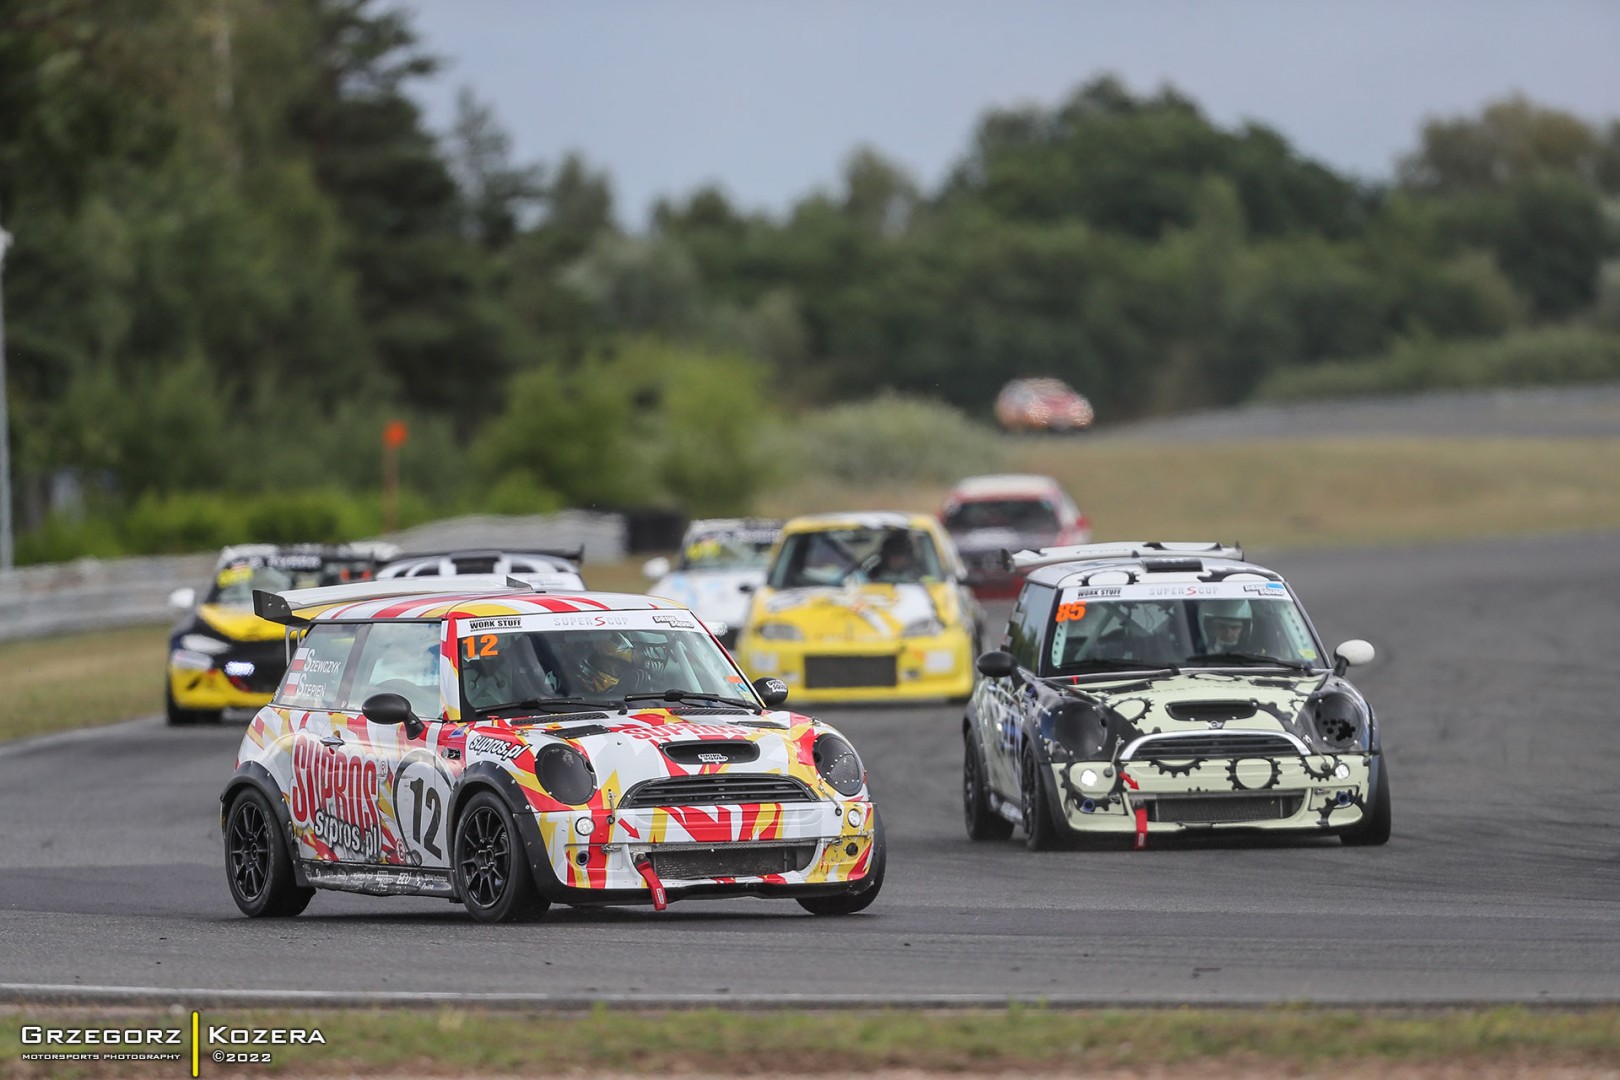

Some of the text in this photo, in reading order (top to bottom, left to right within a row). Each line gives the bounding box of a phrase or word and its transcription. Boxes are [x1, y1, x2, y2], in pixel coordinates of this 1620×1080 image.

[1078, 588, 1121, 597] WORK STUFF
[554, 616, 593, 626] SUPER
[1055, 601, 1086, 622] 85
[470, 618, 522, 630] WORK STUFF
[462, 633, 499, 658] 12
[622, 722, 748, 740] SUPROS
[470, 735, 531, 760] supros.pl
[292, 735, 378, 828] SUPROS
[409, 777, 442, 861] 12
